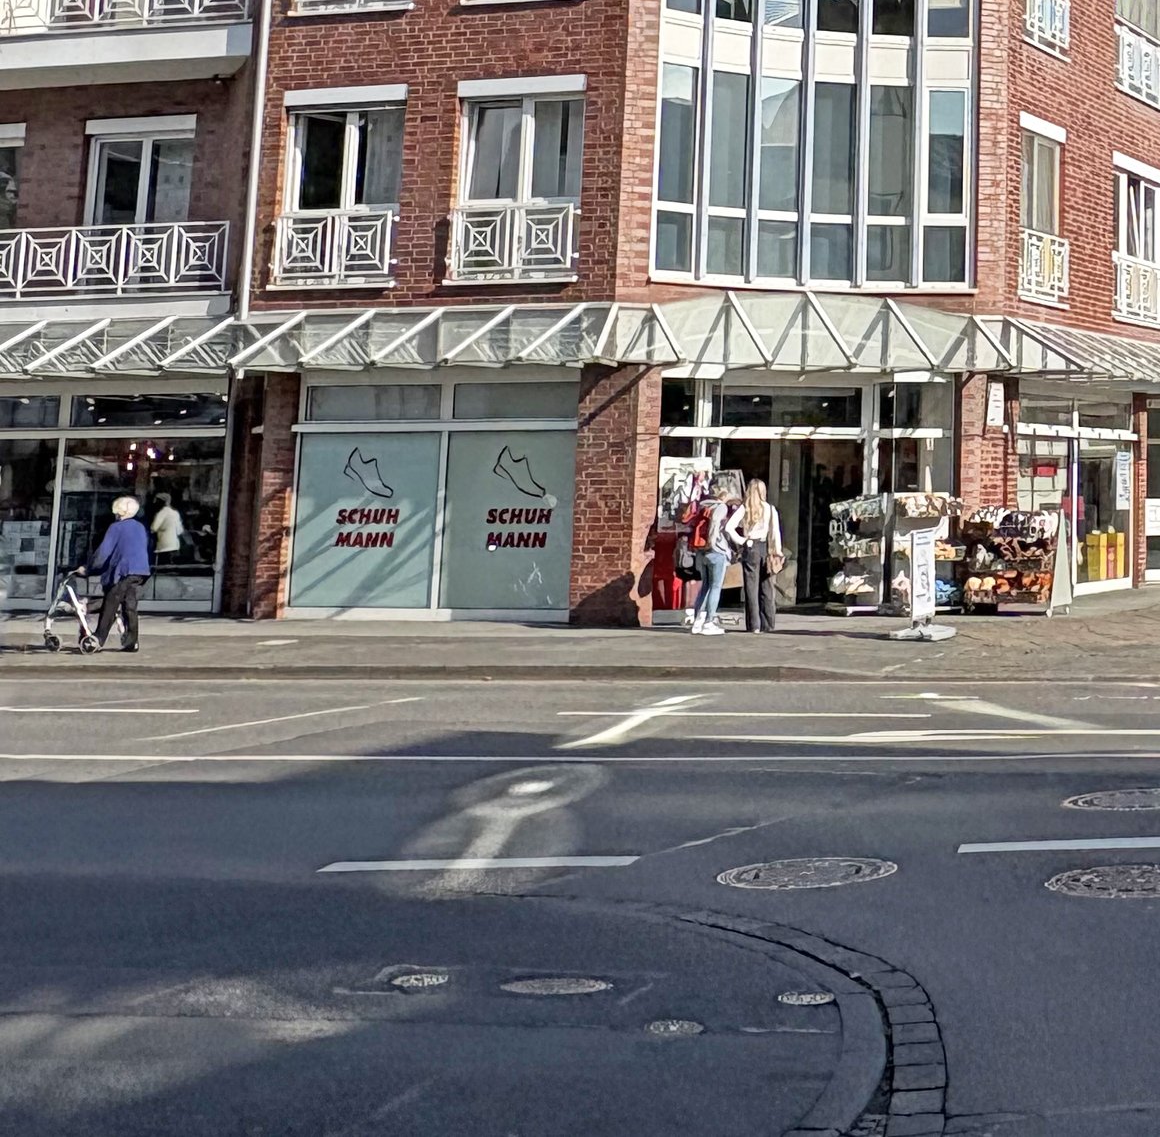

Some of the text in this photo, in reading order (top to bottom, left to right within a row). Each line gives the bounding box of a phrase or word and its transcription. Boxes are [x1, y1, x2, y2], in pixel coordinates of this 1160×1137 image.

[335, 508, 400, 525] SCHUH
[486, 508, 553, 525] SCHUH
[334, 531, 395, 548] MANN
[486, 531, 548, 549] MANN
